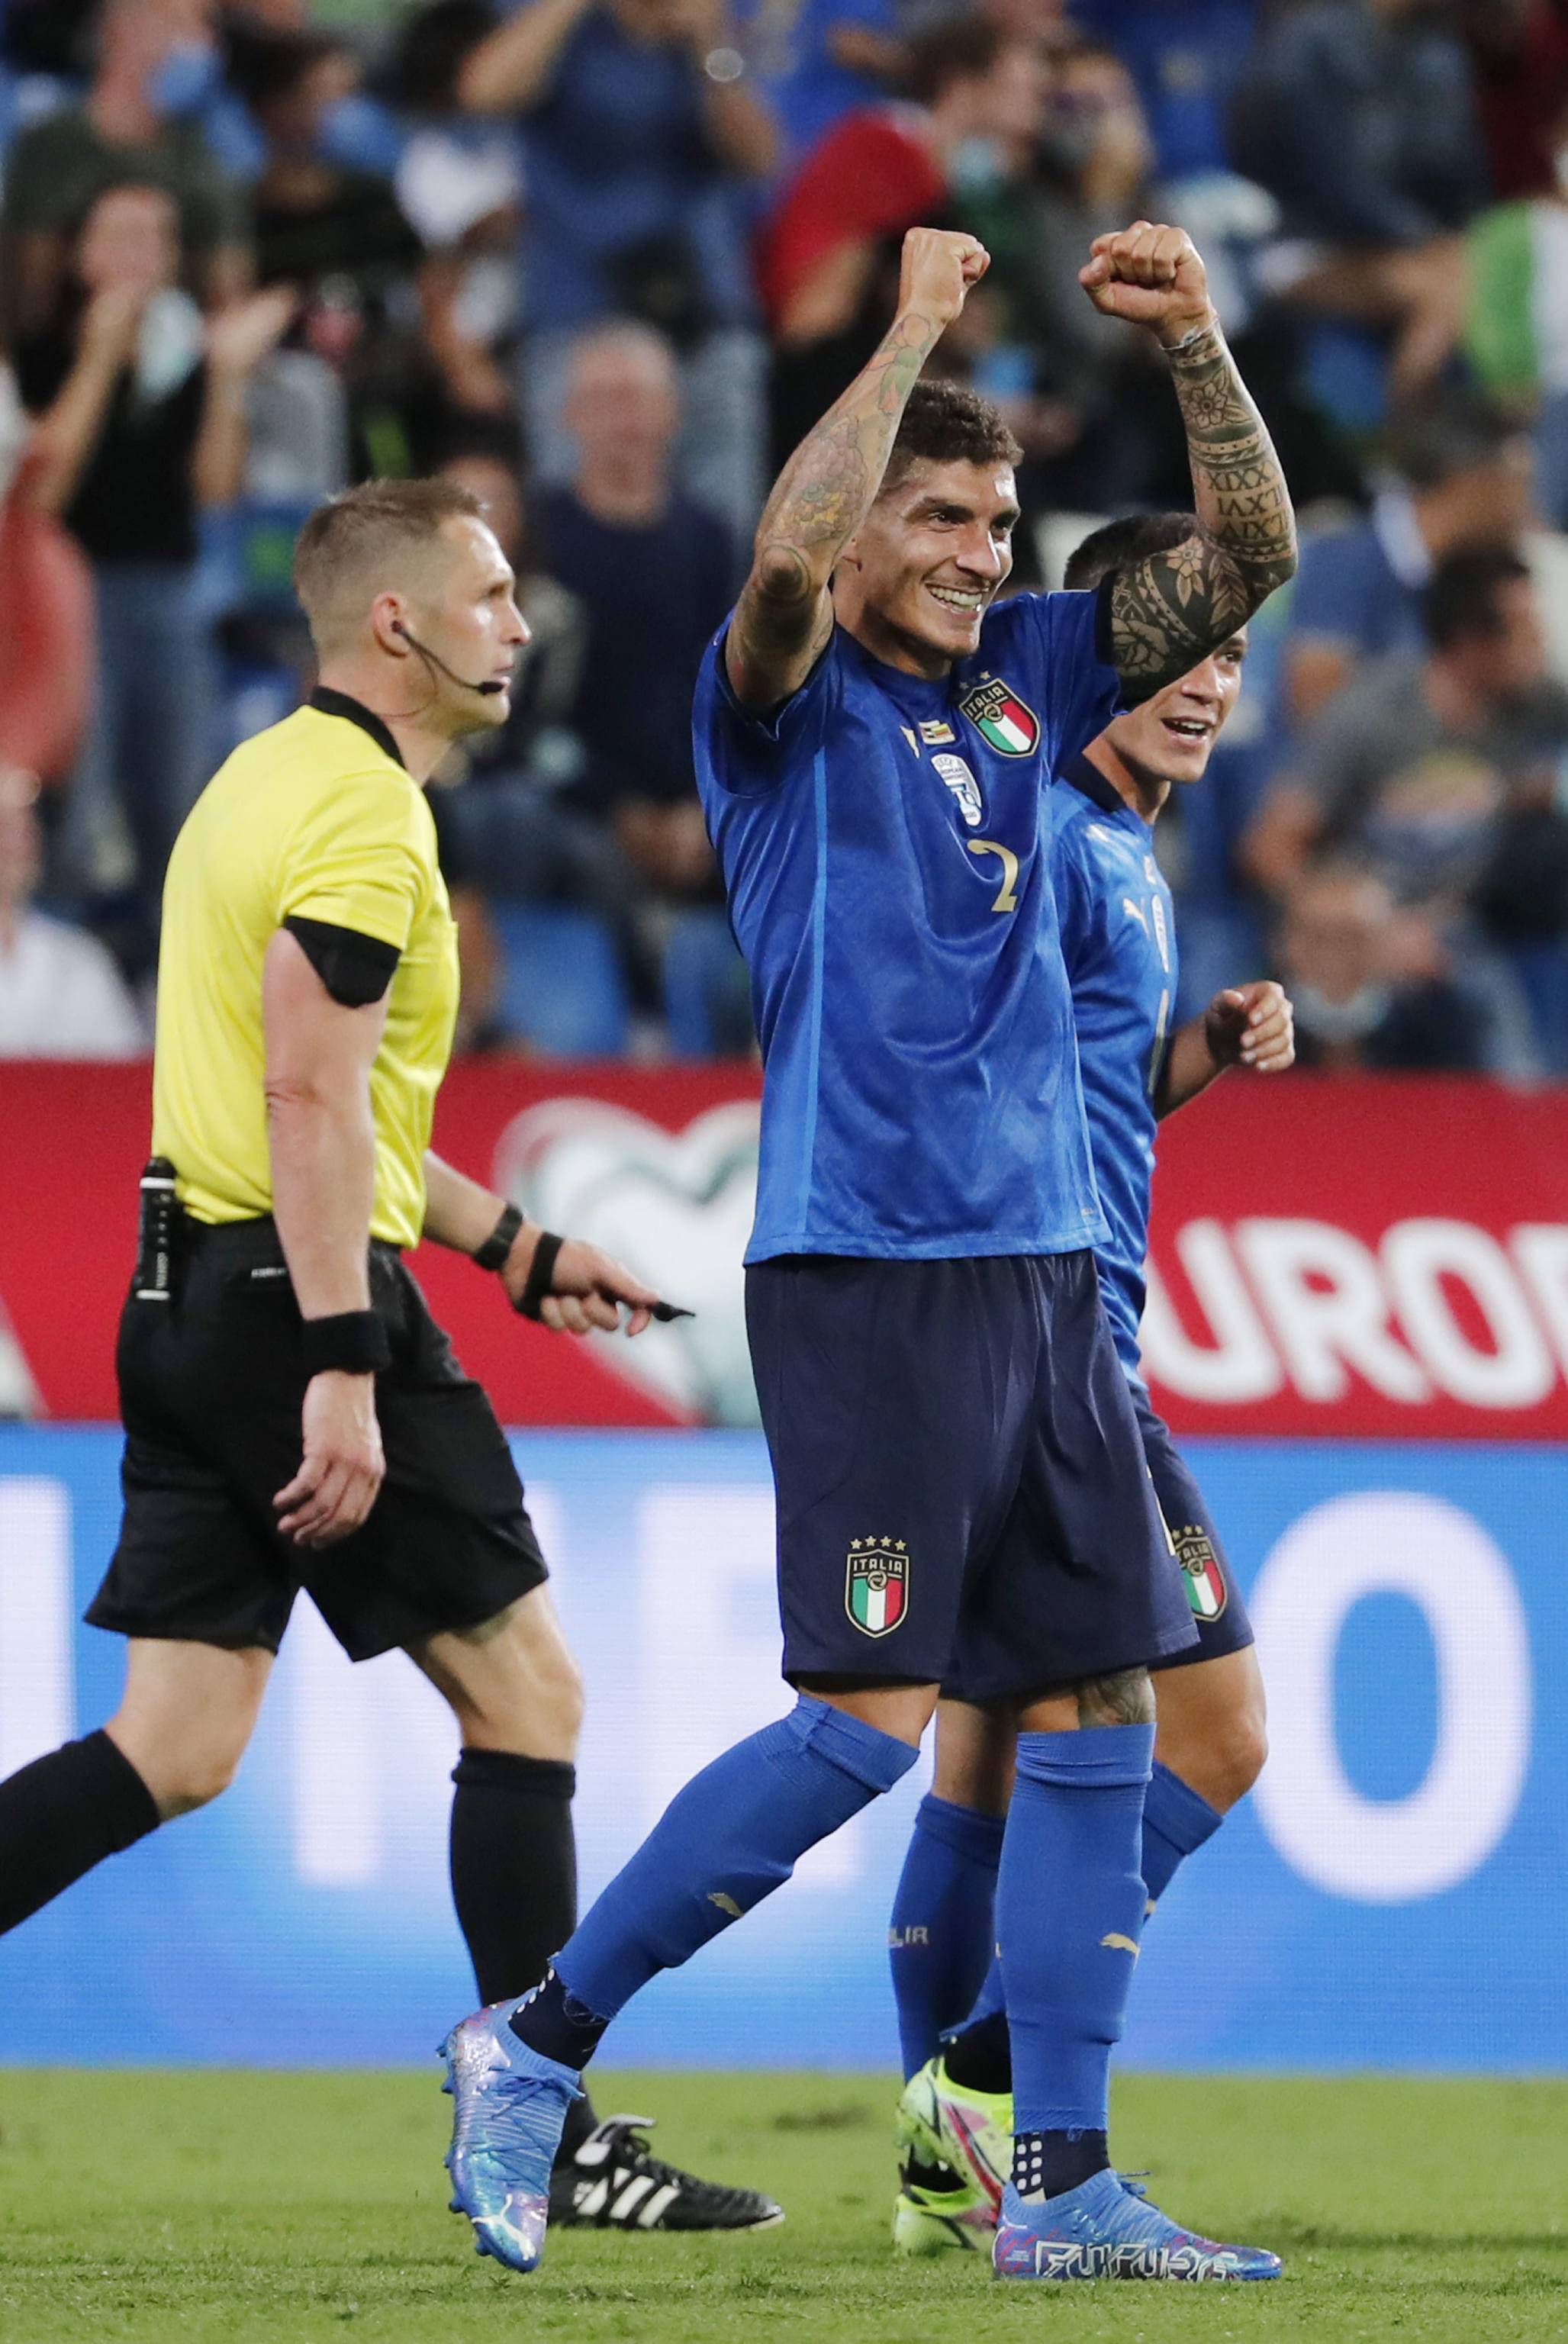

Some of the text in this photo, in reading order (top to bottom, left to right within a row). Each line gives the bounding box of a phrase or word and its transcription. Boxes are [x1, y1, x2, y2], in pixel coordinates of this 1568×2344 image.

[964, 686, 1005, 717] ITALIA
[966, 839, 1019, 913] 2
[1138, 1215, 1568, 1412] URO
[853, 1558, 903, 1573] ITALIA
